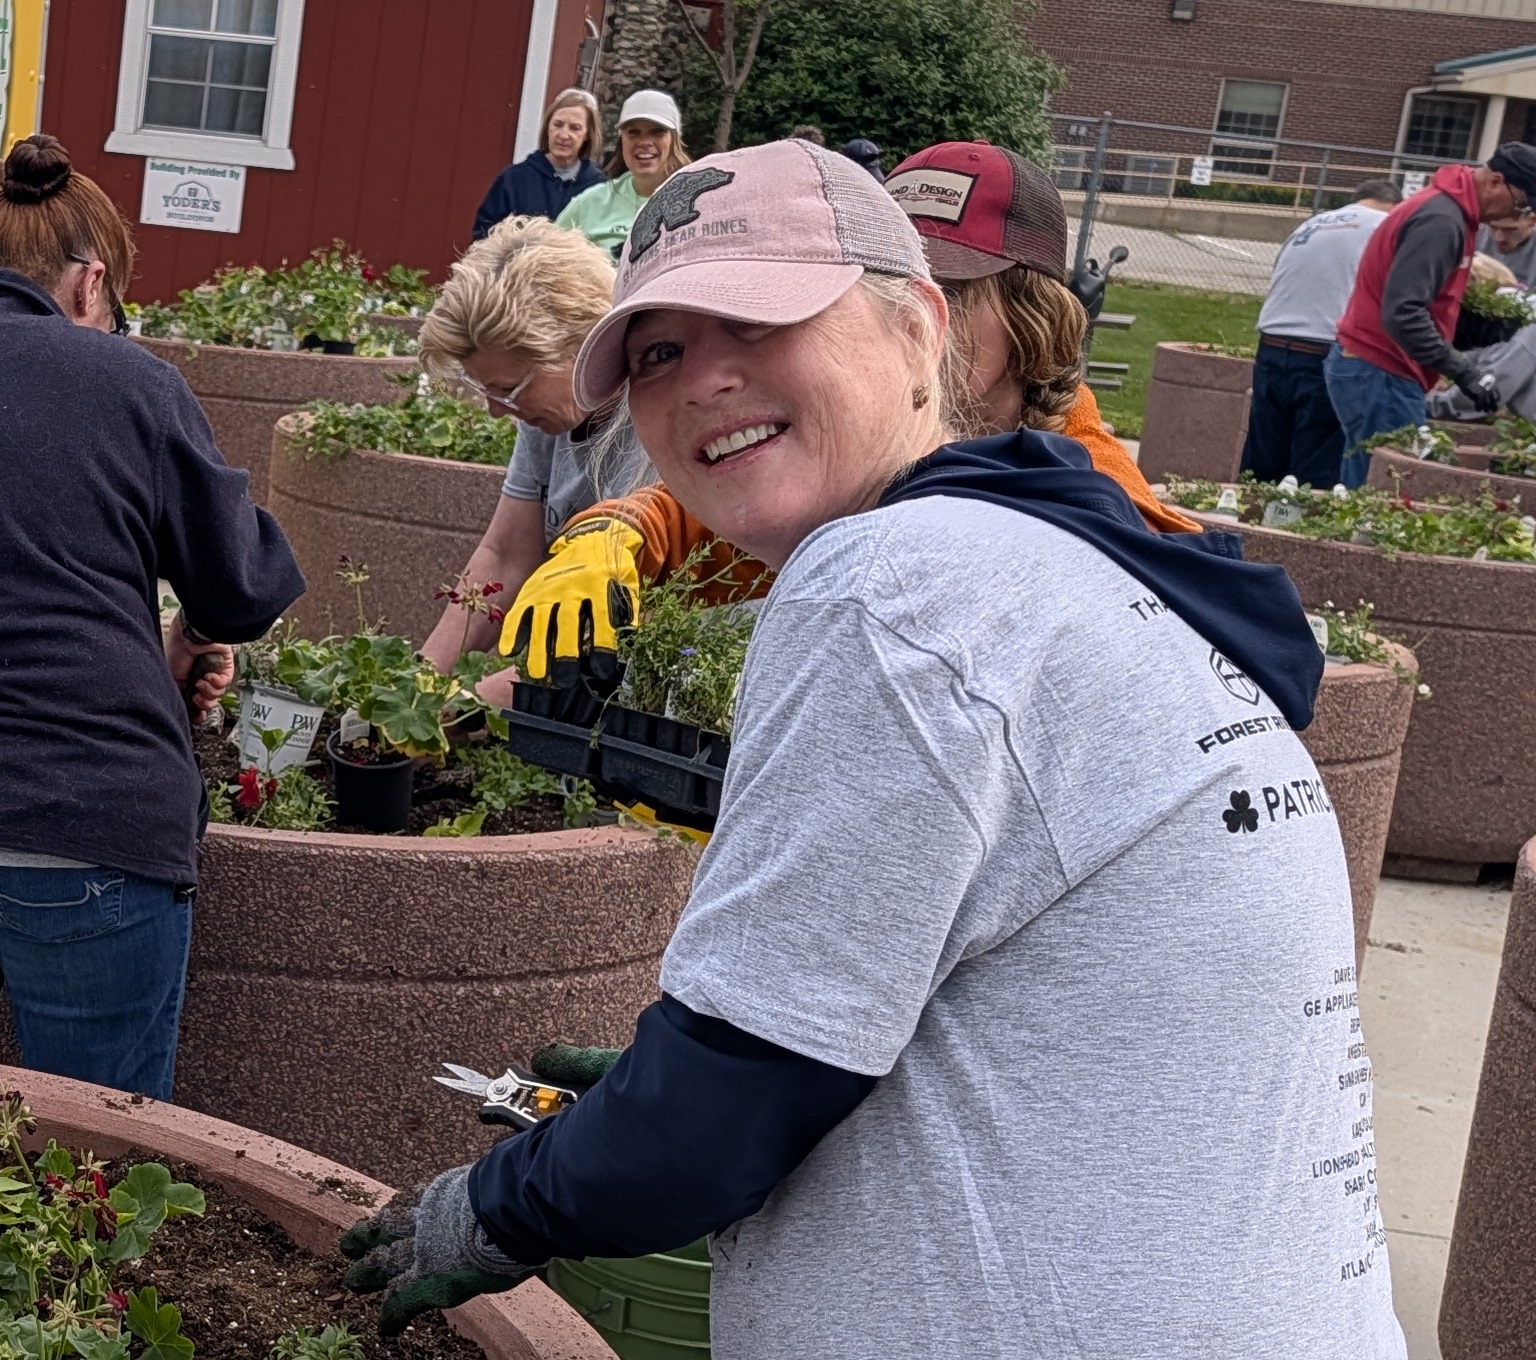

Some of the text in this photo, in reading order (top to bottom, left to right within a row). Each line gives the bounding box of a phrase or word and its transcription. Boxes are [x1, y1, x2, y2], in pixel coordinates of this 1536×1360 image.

[150, 162, 240, 180] Building Provided By
[918, 183, 964, 199] DESIGN
[162, 195, 222, 212] YODER'S
[702, 219, 748, 238] DUNES
[291, 713, 319, 731] PW
[1194, 716, 1273, 755] FOREST
[1262, 779, 1334, 823] PATRIC
[1303, 1000, 1321, 1017] GE
